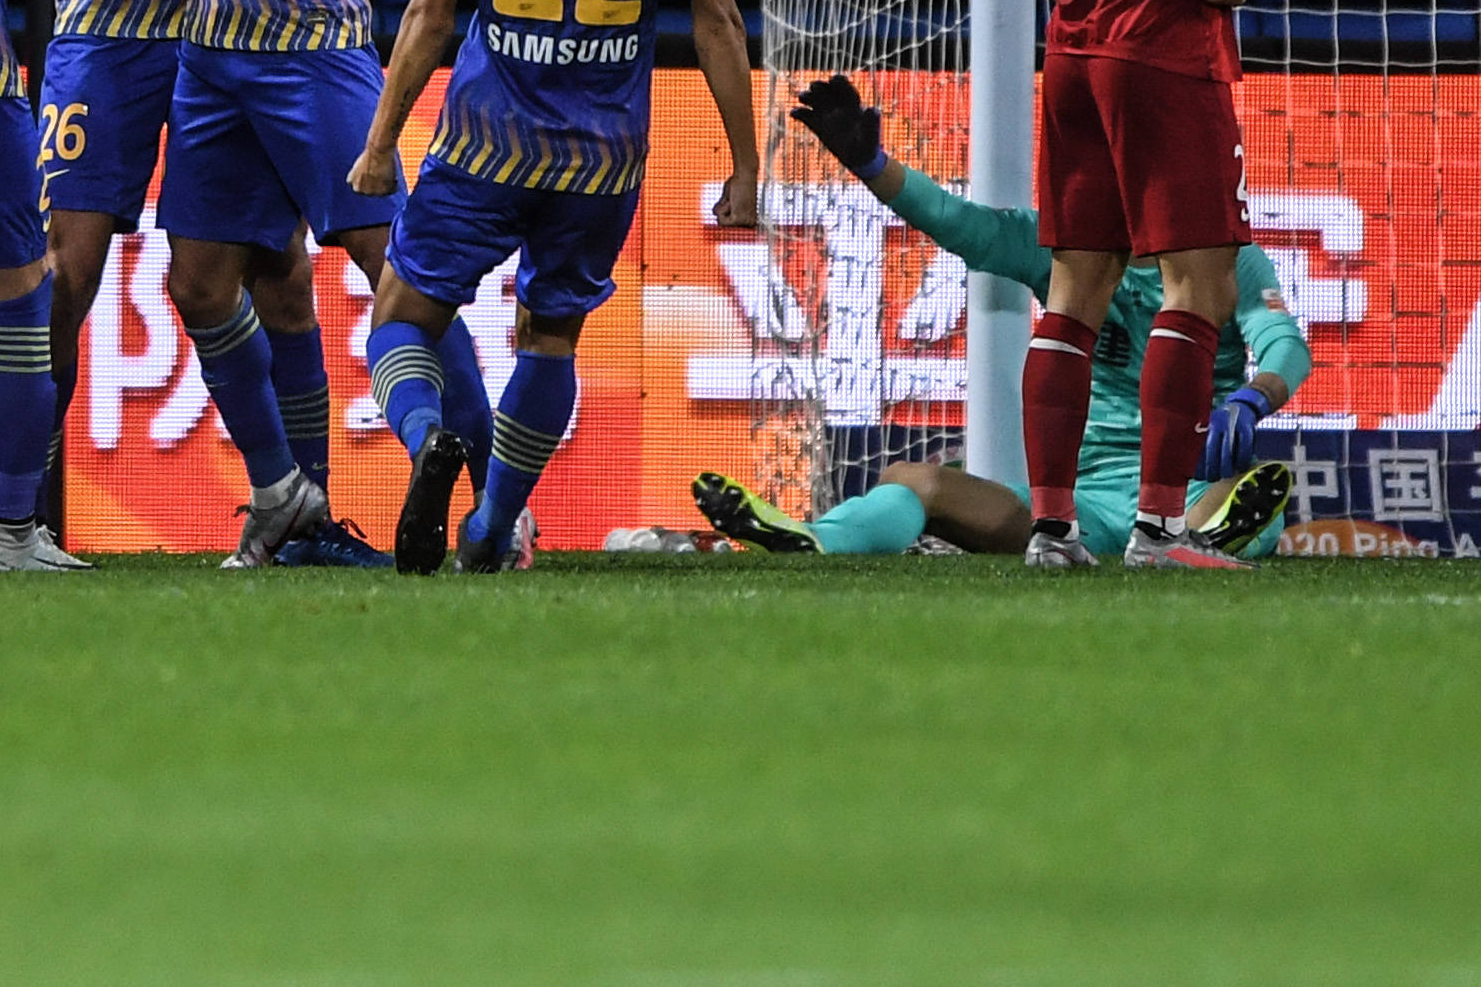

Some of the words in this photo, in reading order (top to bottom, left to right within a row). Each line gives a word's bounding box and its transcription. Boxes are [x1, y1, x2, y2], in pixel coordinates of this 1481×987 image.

[487, 23, 639, 65] SAMSUNG
[40, 102, 89, 161] 26
[1291, 445, 1481, 523] 中国
